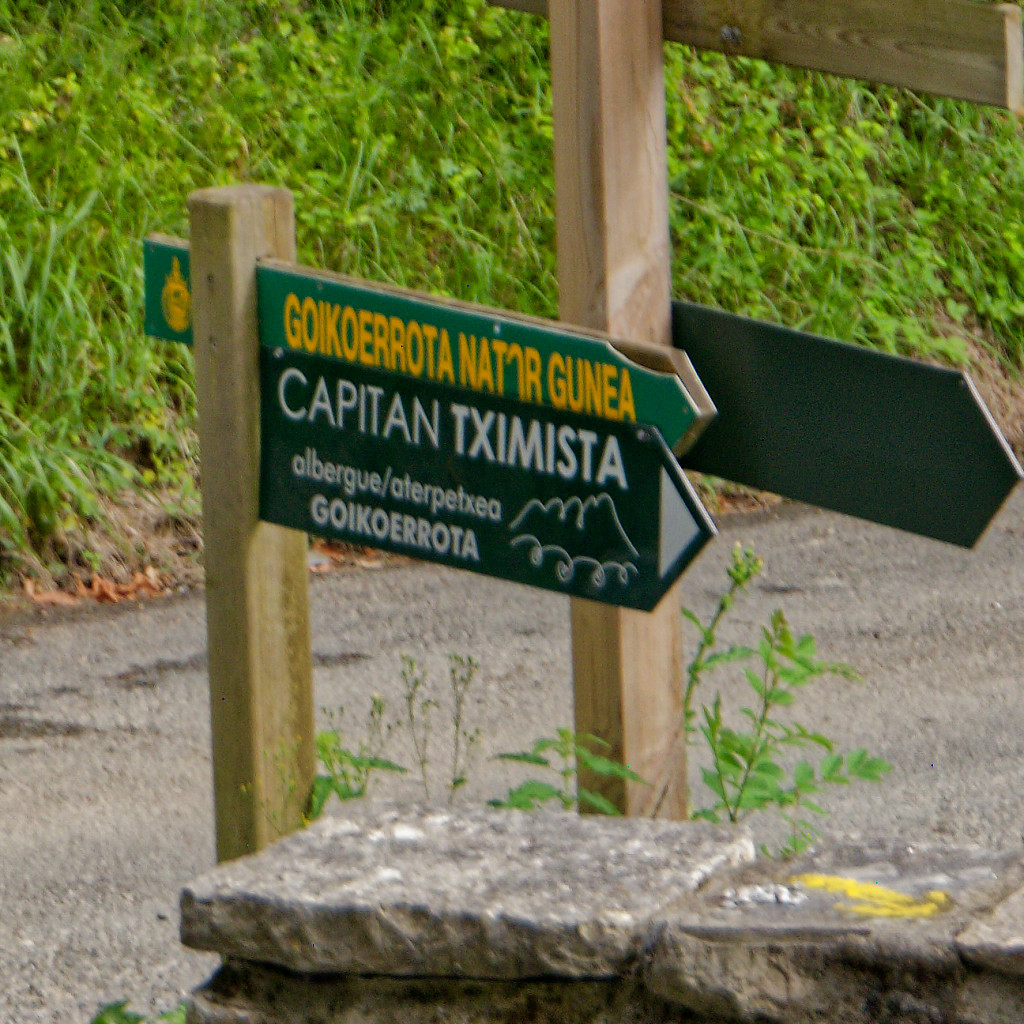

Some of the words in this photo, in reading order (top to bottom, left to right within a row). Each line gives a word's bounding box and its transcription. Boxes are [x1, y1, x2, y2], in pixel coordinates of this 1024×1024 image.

[283, 292, 454, 381] GOIKOERROTA
[548, 351, 637, 424] GUNEA
[277, 367, 440, 450] CAPITAN
[450, 403, 629, 490] TXIMISTA
[291, 445, 503, 522] albergue/aterpetxea
[310, 493, 480, 561] GOIKOERROTA
